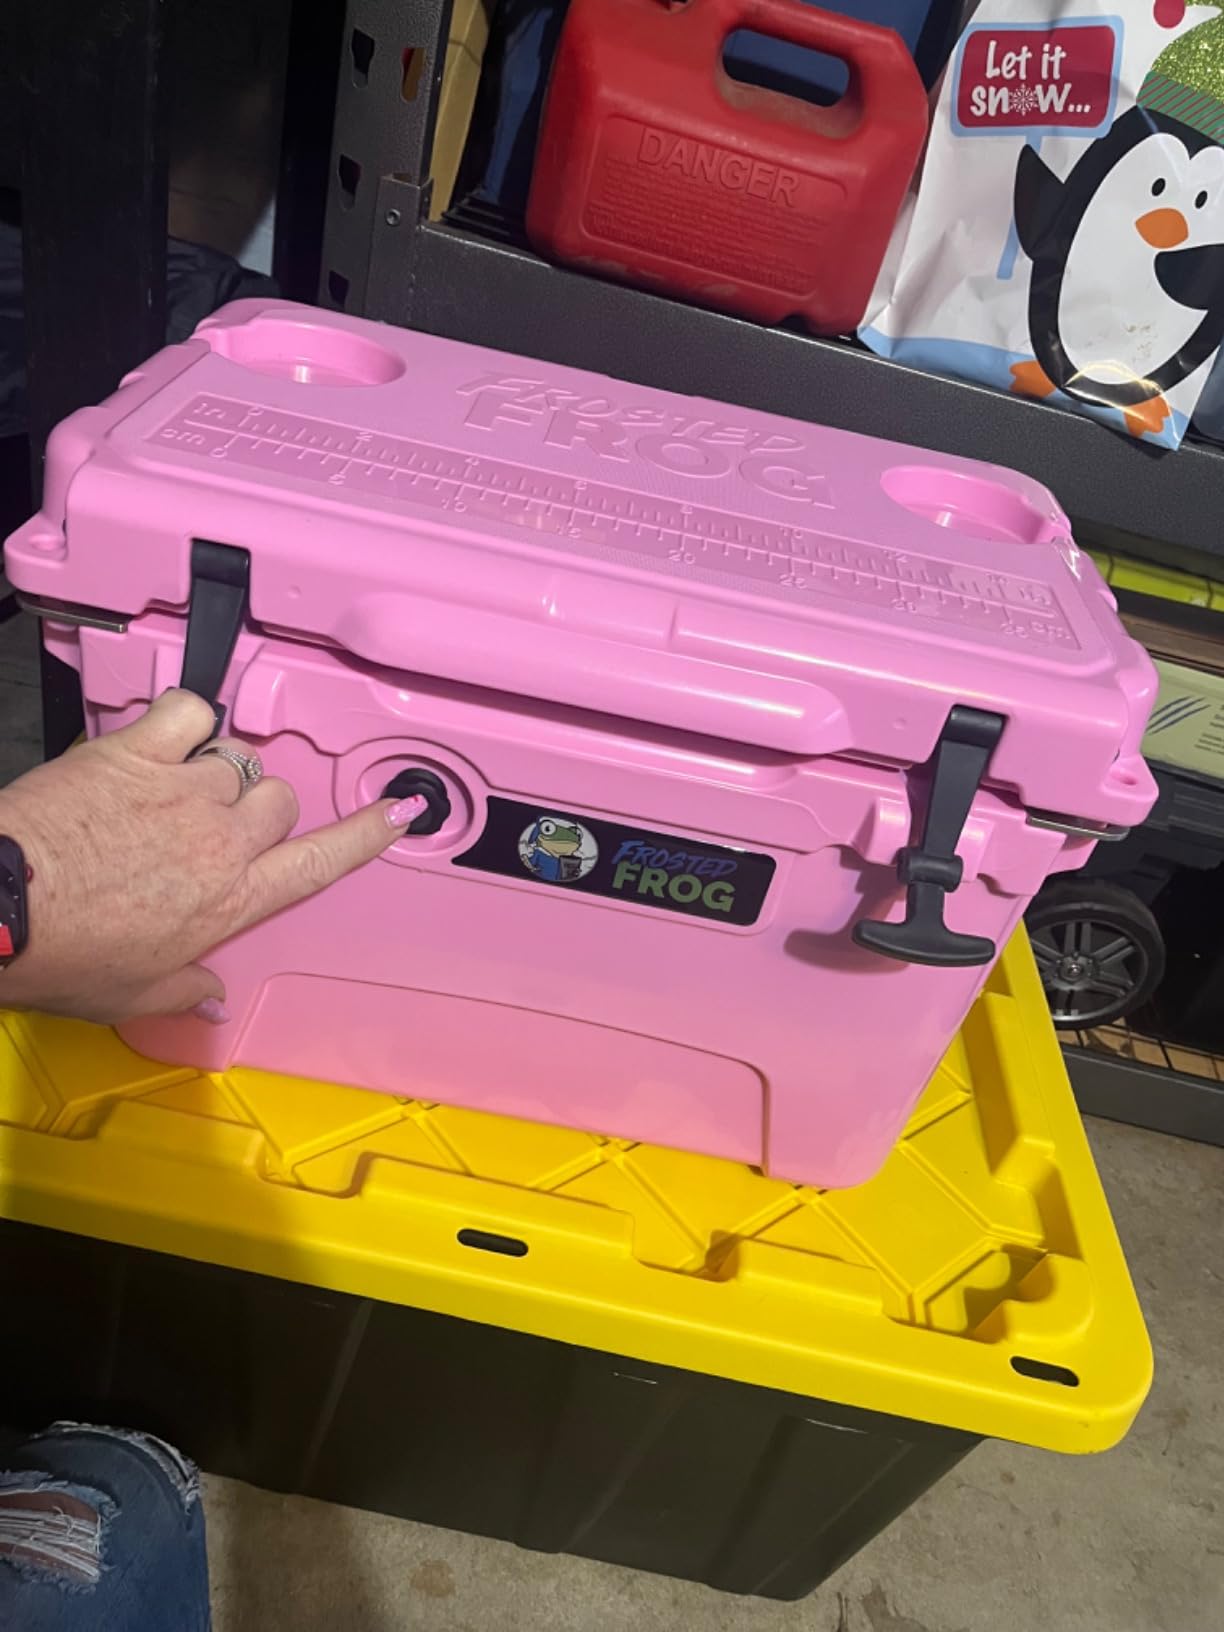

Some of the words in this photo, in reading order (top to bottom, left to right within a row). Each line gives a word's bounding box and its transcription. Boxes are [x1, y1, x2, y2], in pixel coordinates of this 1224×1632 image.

[985, 40, 1032, 80] Let
[1041, 42, 1067, 80] it
[637, 127, 800, 208] DANGER
[456, 373, 807, 455] FROSTED
[463, 391, 837, 511] FROG
[160, 428, 206, 445] cm
[209, 447, 228, 458] 0
[441, 498, 468, 513] 10
[667, 549, 697, 565] 20
[611, 839, 738, 878] FROSTED
[611, 862, 737, 913] FROG
